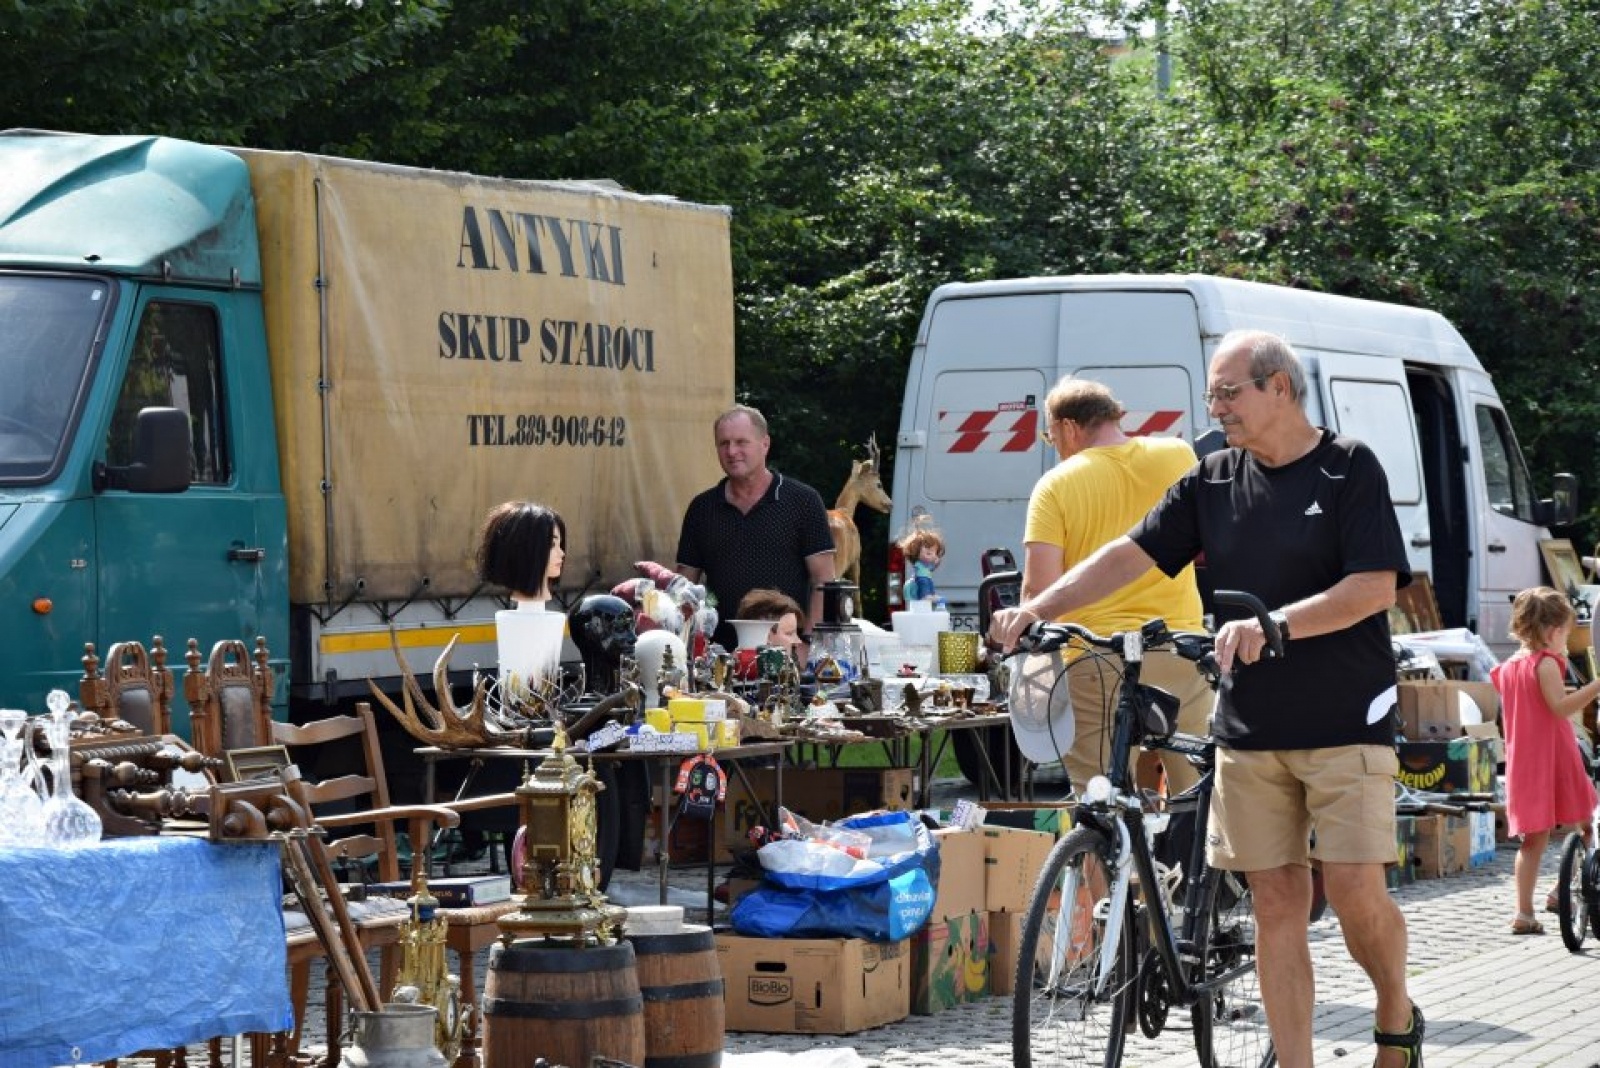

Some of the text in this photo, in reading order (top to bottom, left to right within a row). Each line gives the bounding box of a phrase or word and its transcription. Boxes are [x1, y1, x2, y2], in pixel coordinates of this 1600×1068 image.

[456, 206, 626, 285] ANTYKI
[438, 311, 531, 362] SKUP
[466, 414, 626, 446] TEL.889-908-642
